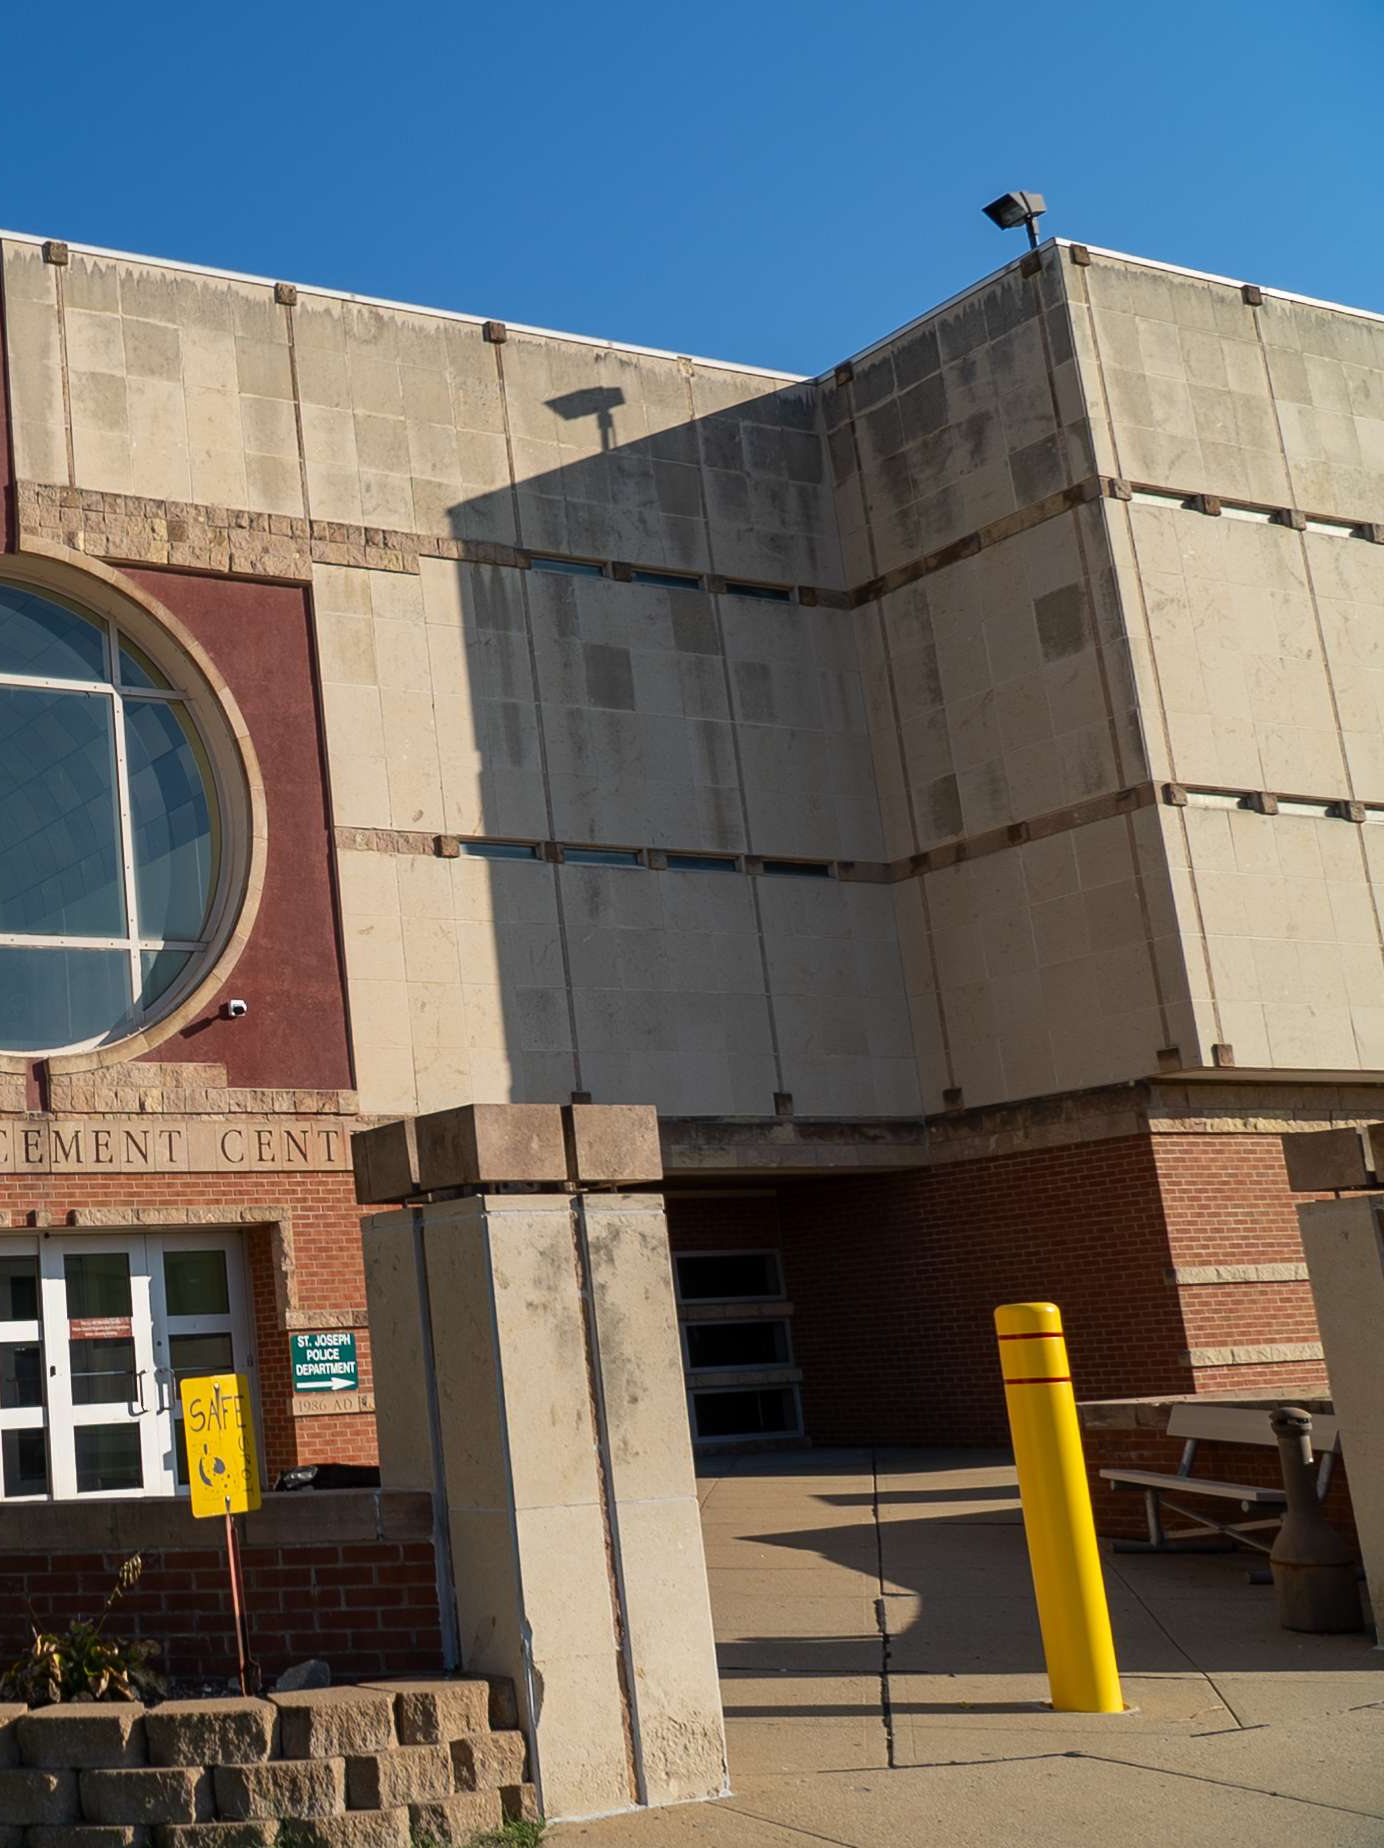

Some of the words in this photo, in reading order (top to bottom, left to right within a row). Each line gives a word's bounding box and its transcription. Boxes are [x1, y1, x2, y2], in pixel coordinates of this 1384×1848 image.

[220, 1129, 359, 1164] CENT
[297, 1335, 313, 1348] ST.
[314, 1333, 351, 1347] JOSEPH
[306, 1348, 340, 1361] POLICE
[296, 1361, 356, 1376] DEPARTMENT
[298, 1400, 327, 1412] 1986
[335, 1398, 353, 1409] AD
[189, 1395, 246, 1432] SAFE
